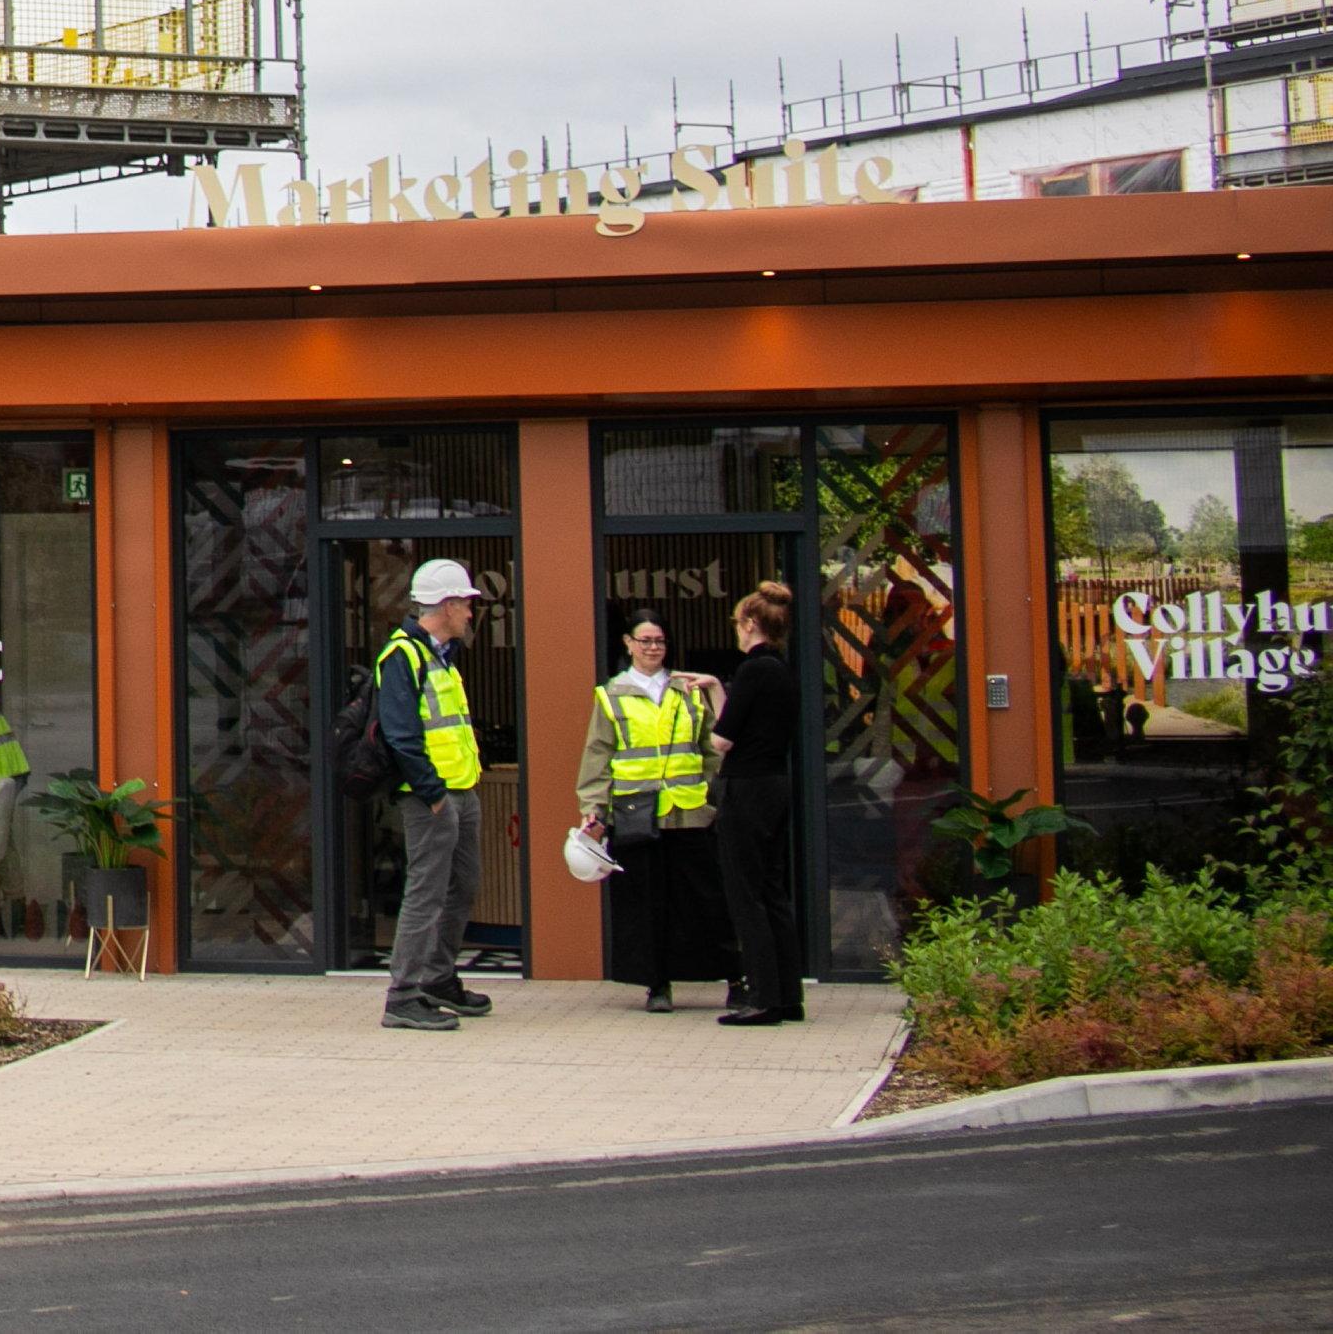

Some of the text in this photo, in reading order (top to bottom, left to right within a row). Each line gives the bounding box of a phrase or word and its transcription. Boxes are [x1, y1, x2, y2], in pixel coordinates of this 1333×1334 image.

[188, 138, 914, 238] Marketing Suite
[1112, 590, 1333, 646] Collyhu
[1124, 637, 1317, 693] Village
